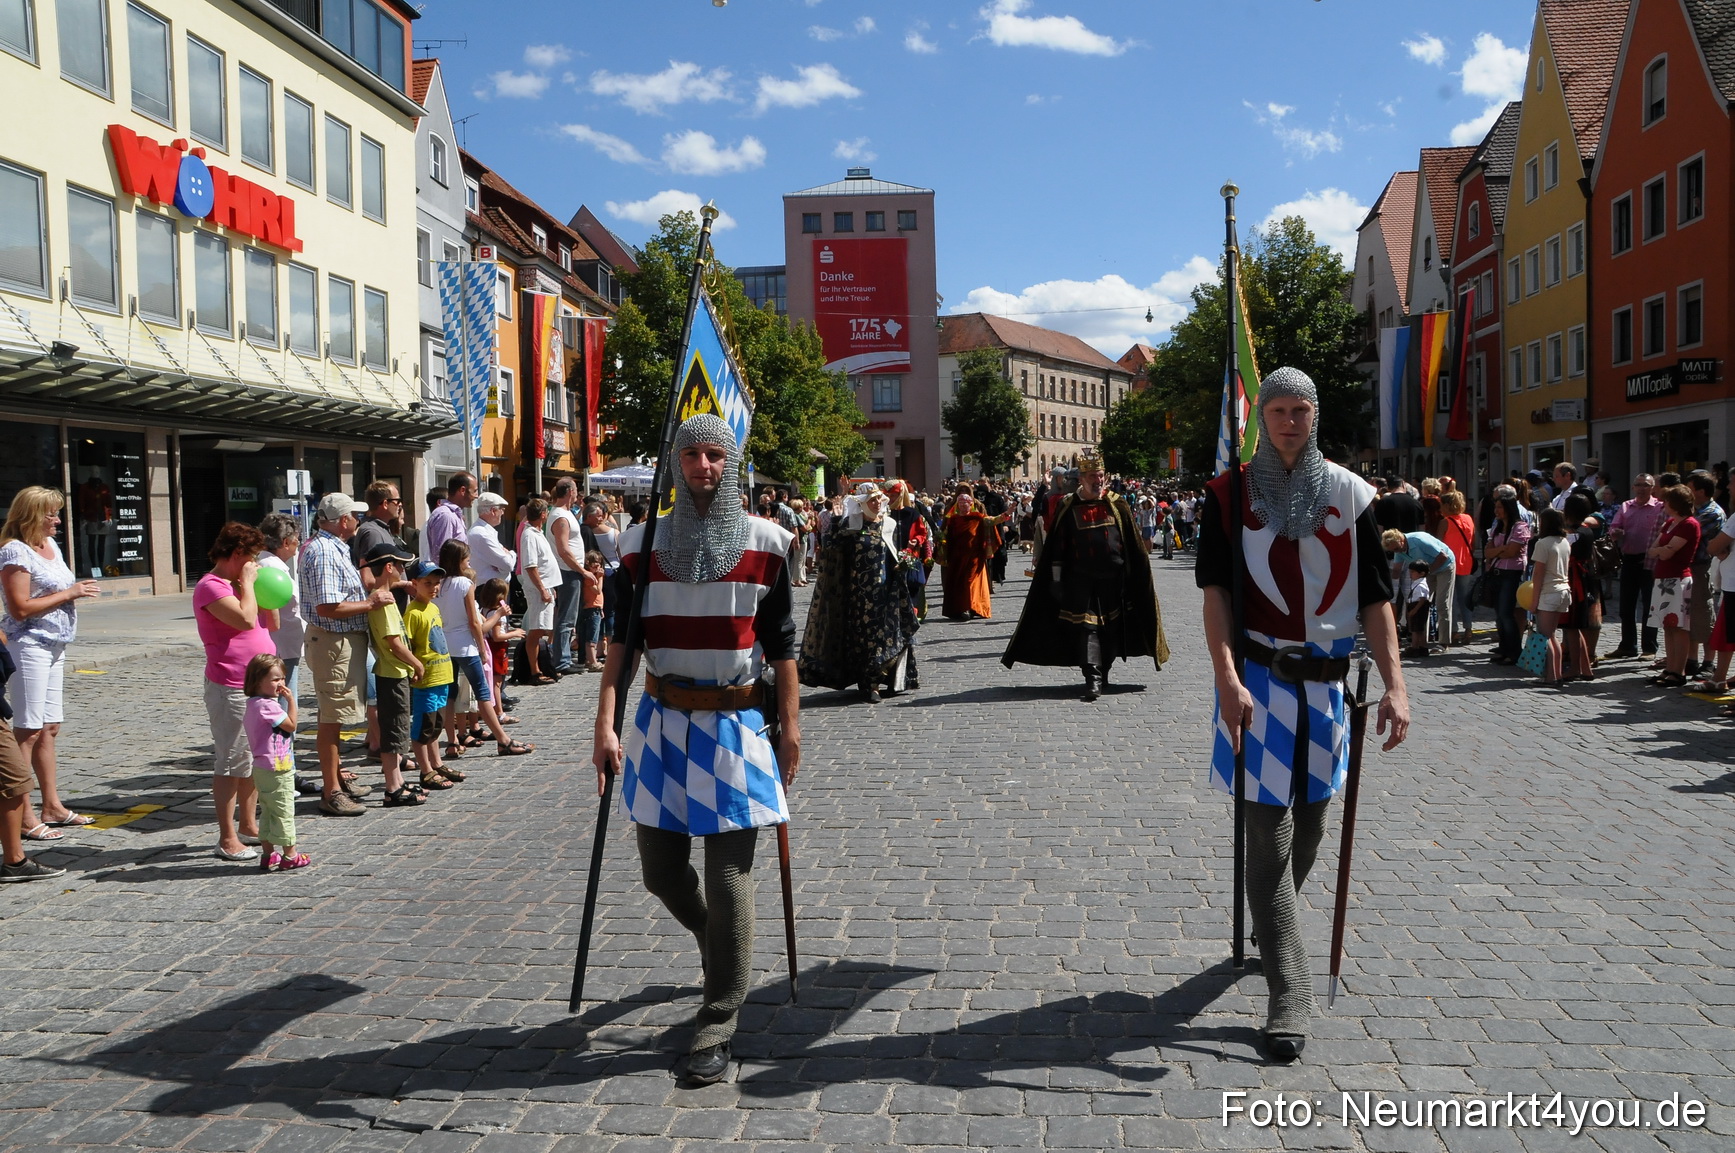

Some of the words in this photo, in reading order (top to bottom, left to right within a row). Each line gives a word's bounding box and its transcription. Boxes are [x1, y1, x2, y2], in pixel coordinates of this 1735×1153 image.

[107, 124, 303, 253] WÖHRL
[820, 271, 854, 281] Danke
[849, 319, 880, 332] 175
[850, 332, 881, 340] JAHRE
[1682, 361, 1714, 372] MATT
[1685, 373, 1708, 381] optik
[231, 488, 253, 500] Aktion
